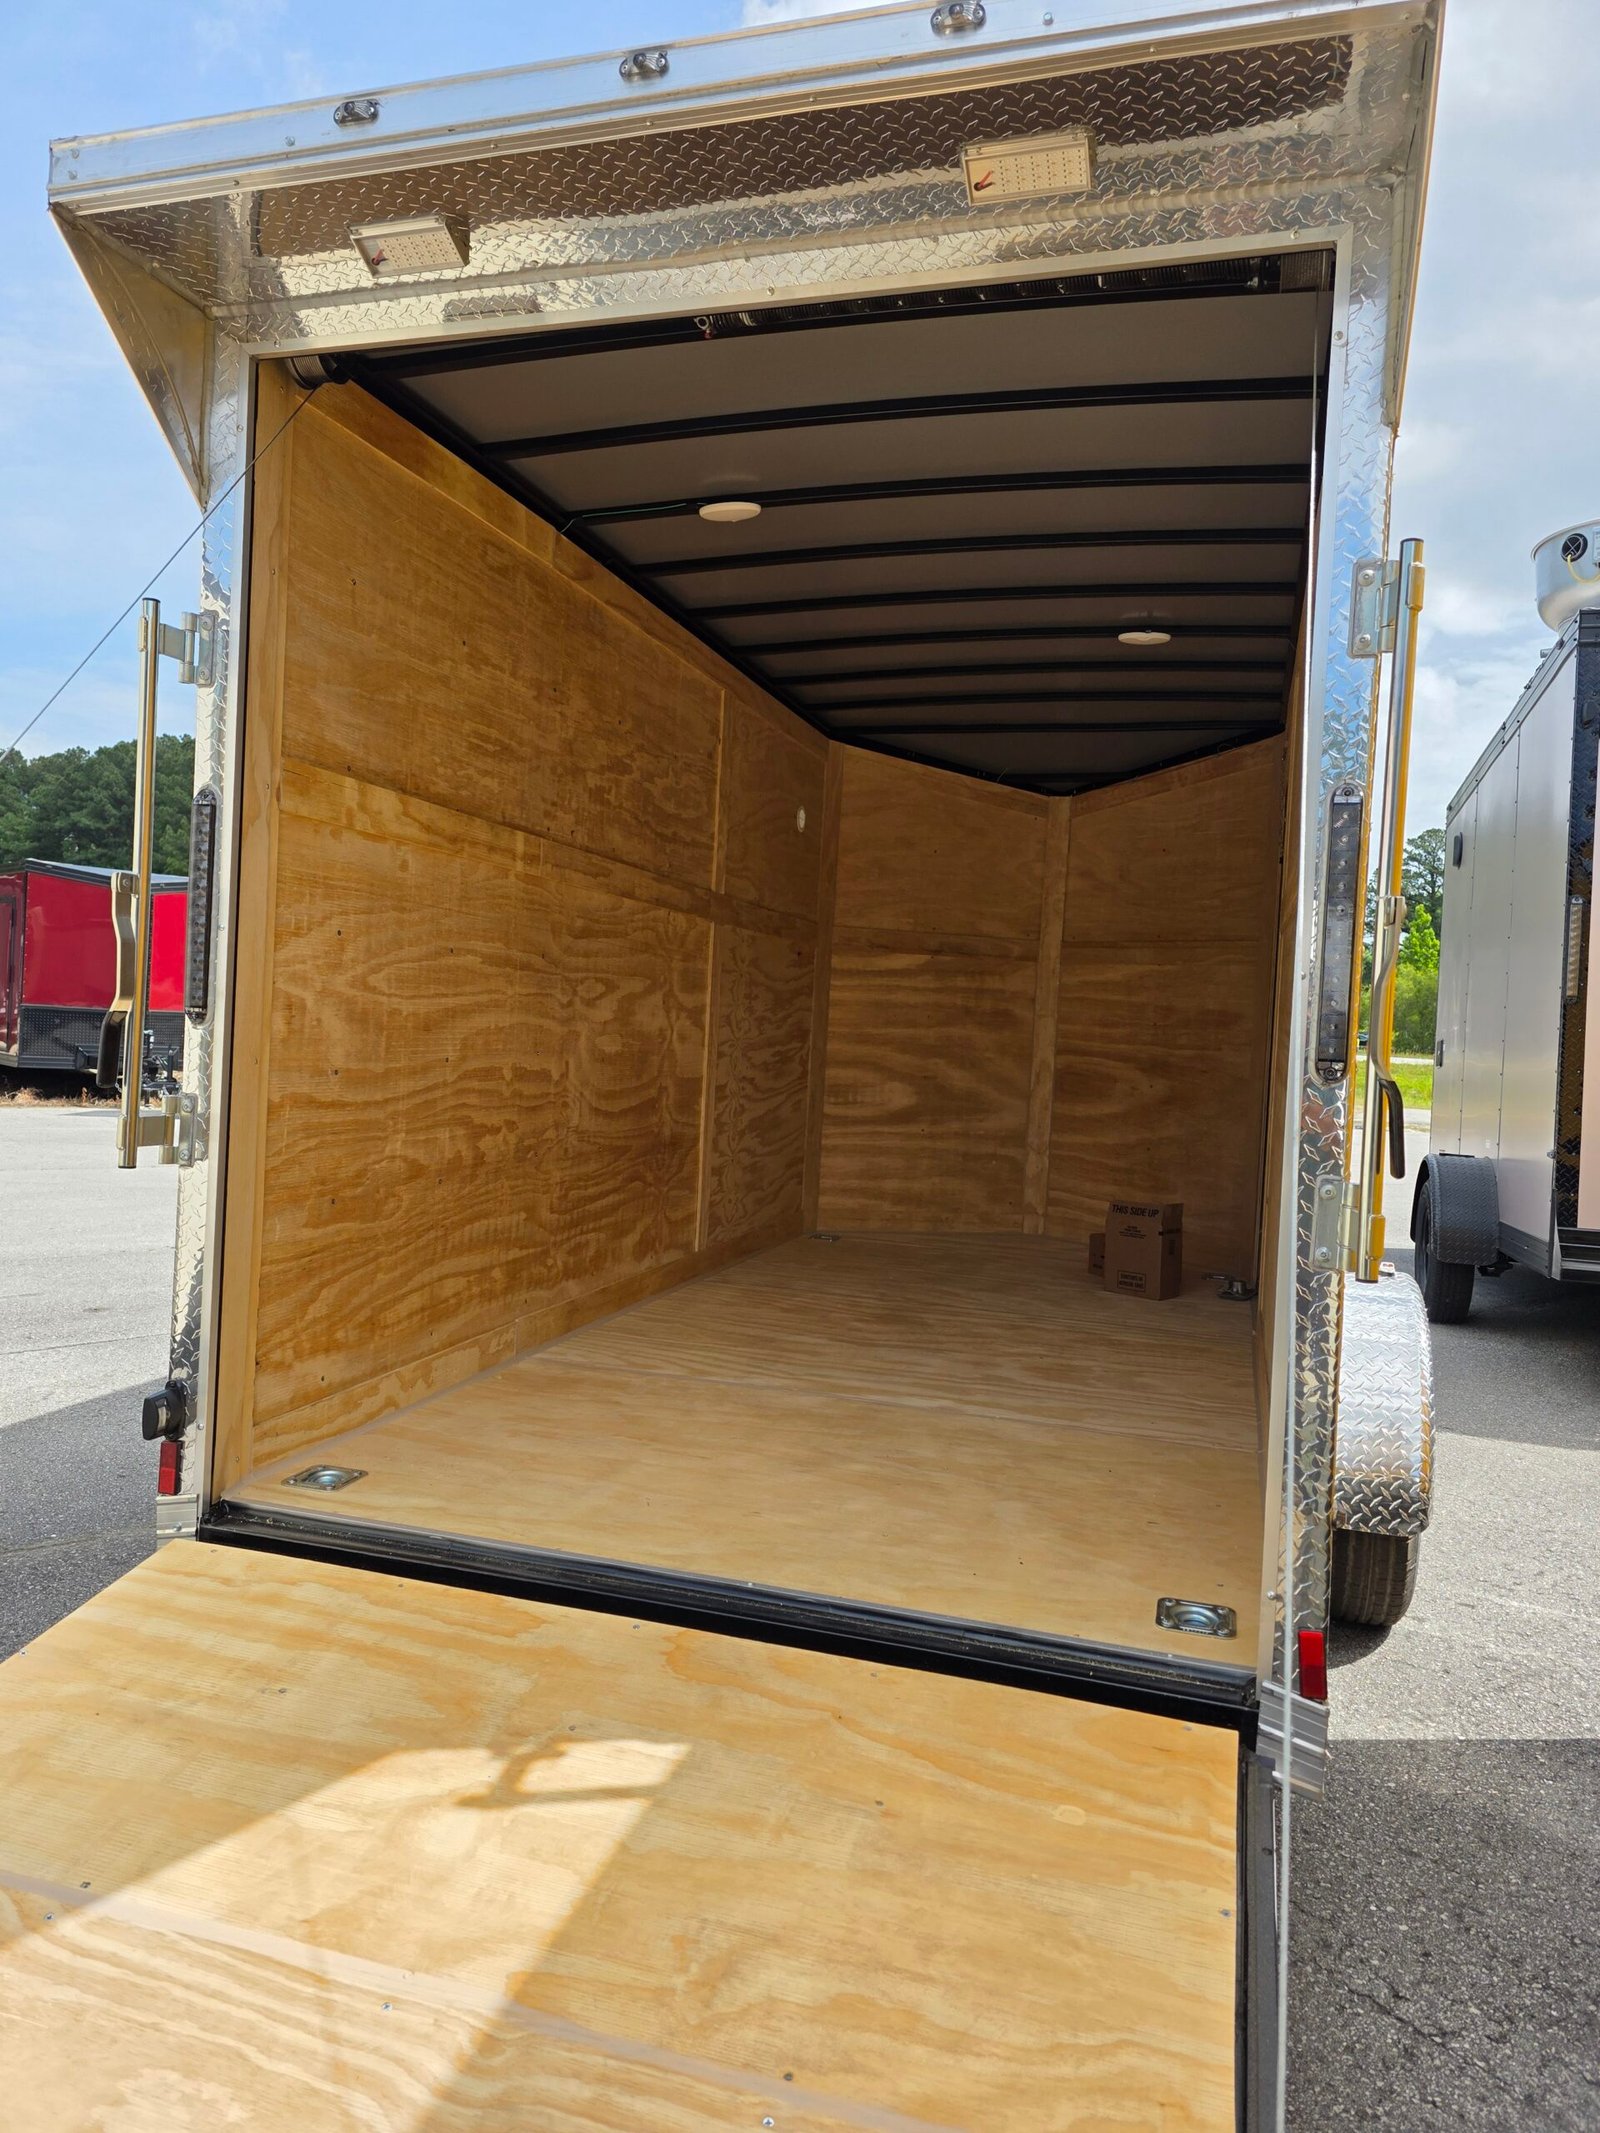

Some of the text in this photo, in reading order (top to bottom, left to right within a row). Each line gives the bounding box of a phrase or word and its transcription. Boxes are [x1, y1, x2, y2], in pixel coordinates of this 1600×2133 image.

[1112, 1204, 1159, 1218] THIS SIDE UP
